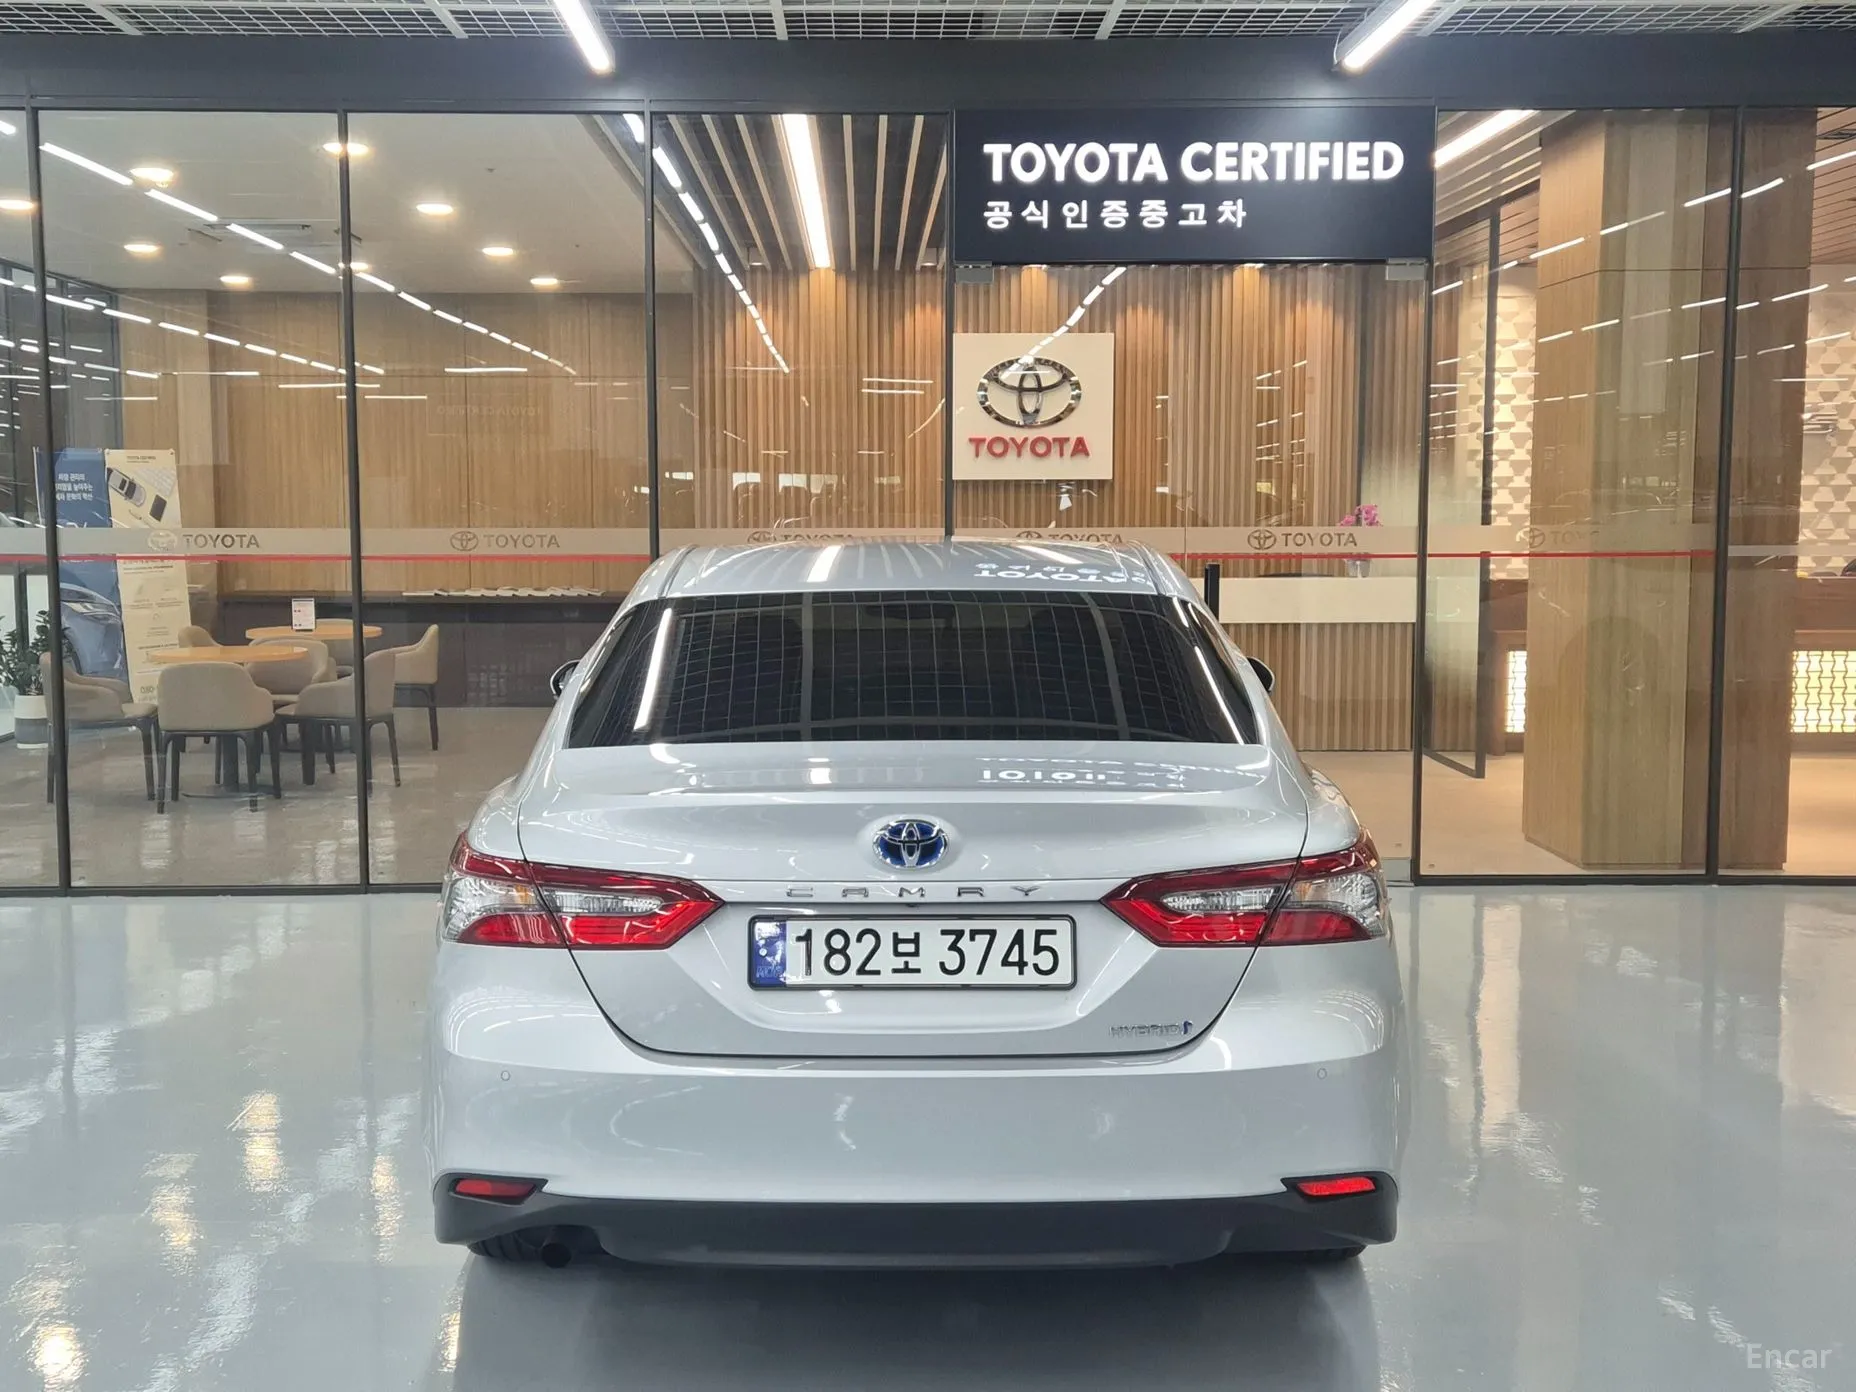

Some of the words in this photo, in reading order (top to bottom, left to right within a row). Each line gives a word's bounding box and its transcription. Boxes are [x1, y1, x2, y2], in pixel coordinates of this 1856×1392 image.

[983, 141, 1168, 183] TOYOTA
[1180, 141, 1405, 182] CERTIFIED
[969, 436, 1091, 459] TOYOTA
[182, 534, 260, 549] TOYOTA
[483, 534, 560, 549] TOYOTA
[1281, 532, 1357, 547] TOYOTA
[786, 885, 1041, 898] CAMRY
[795, 928, 922, 976] 182보
[939, 928, 1060, 976] 3745
[1110, 1024, 1179, 1037] HYBRID
